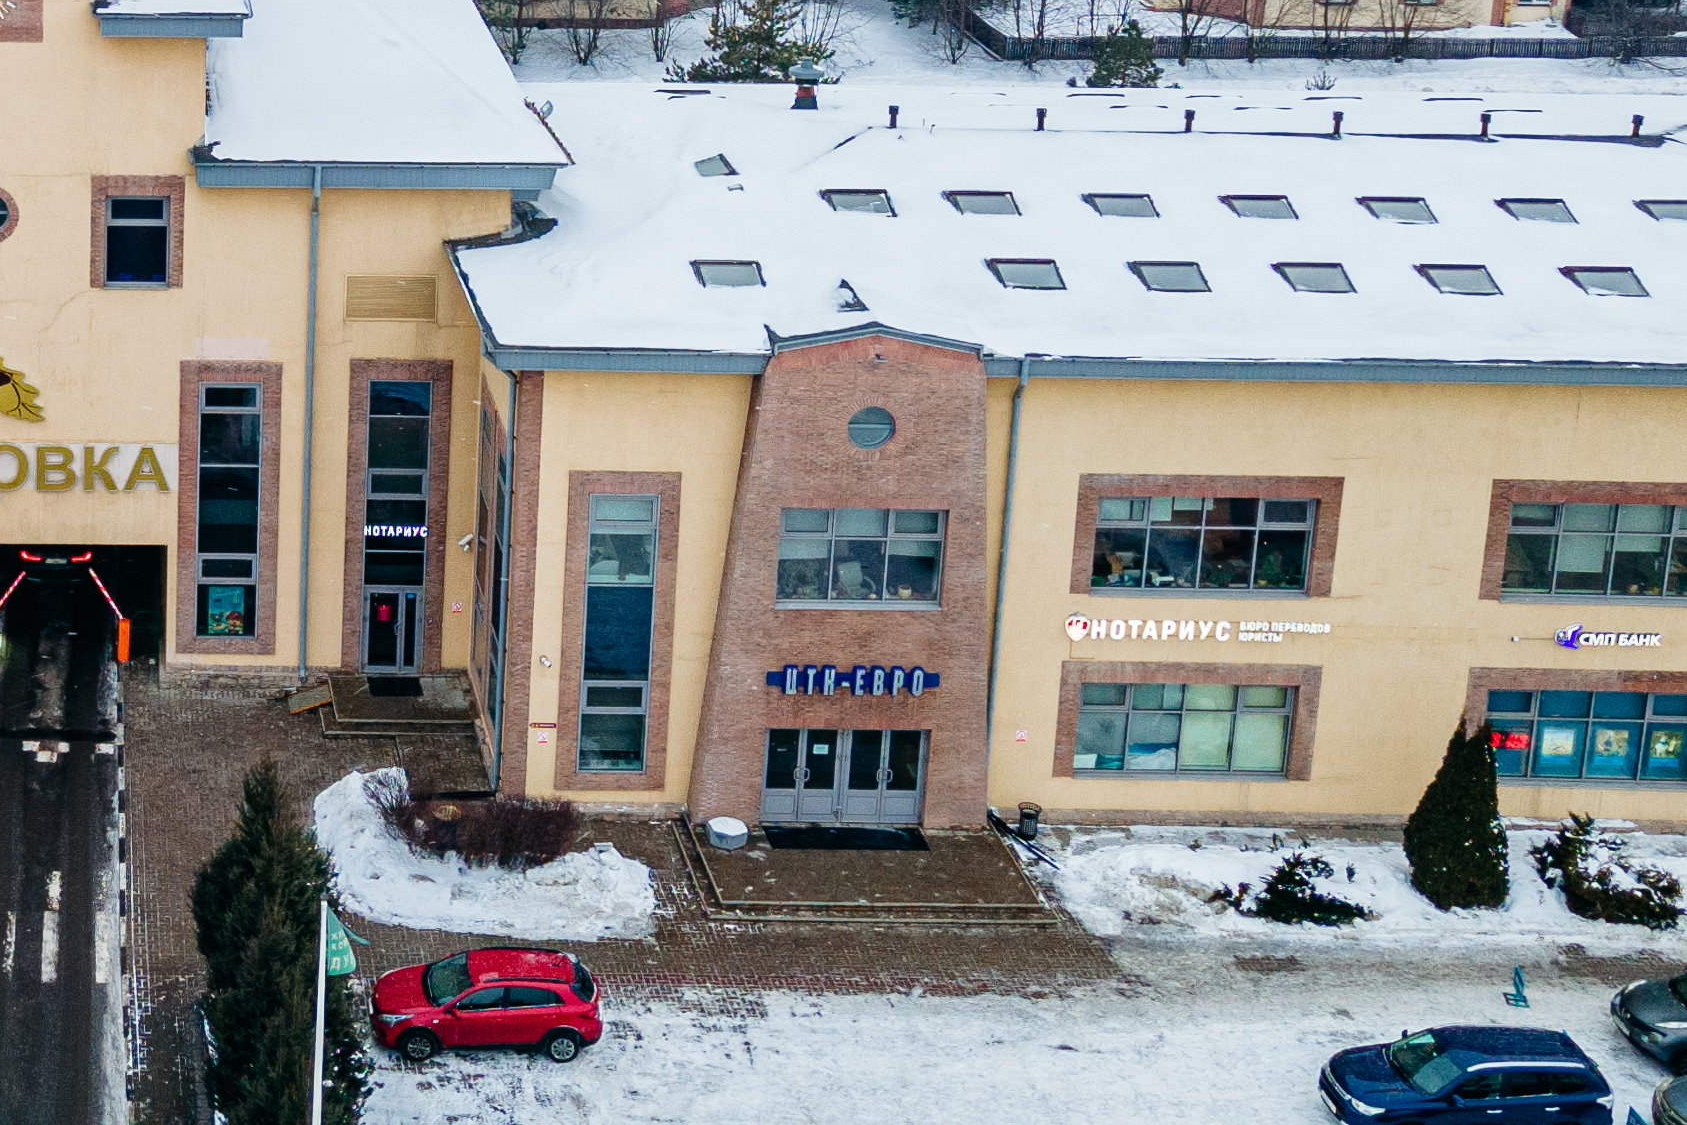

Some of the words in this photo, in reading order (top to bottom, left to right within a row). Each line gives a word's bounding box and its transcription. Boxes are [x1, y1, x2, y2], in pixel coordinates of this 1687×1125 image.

[363, 524, 429, 538] НОТАРИУС
[1090, 619, 1232, 642] НОТАРИУС
[1239, 620, 1270, 632] БЮРО
[1271, 621, 1331, 634] ПЕРЕВОДОВ
[1238, 631, 1284, 643] ЮРИСТЫ
[1579, 632, 1617, 646] СМП
[1618, 633, 1662, 647] БАНК
